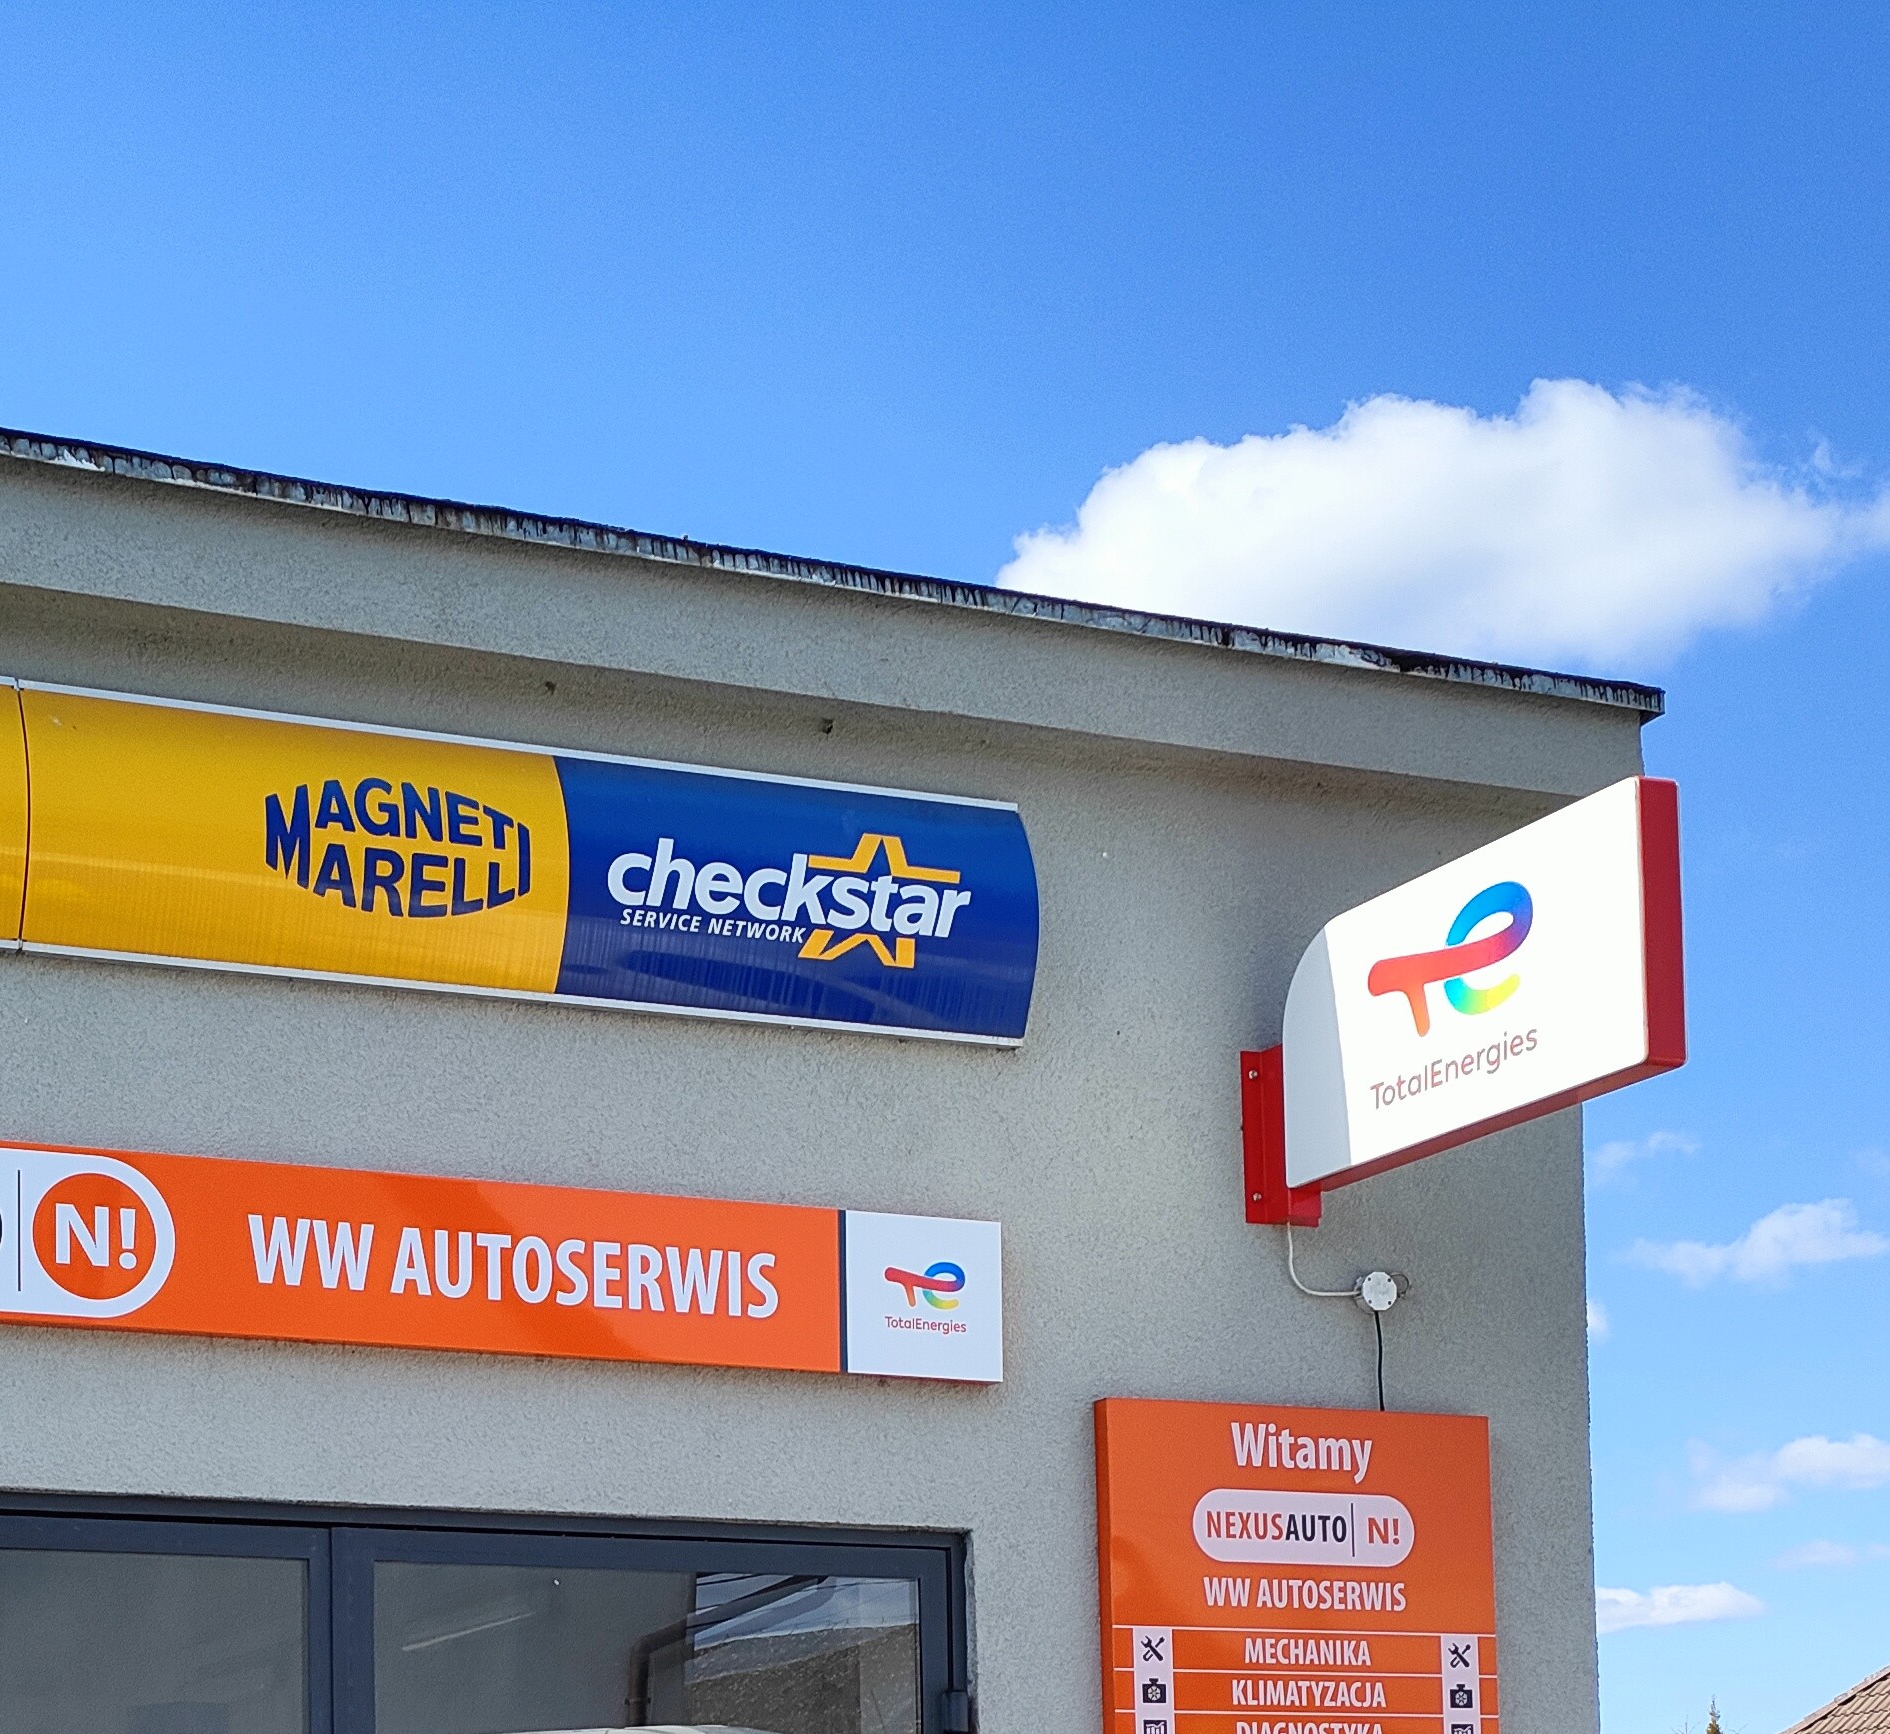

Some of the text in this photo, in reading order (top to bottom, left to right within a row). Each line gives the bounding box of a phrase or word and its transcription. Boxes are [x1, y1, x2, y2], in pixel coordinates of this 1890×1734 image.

[265, 777, 530, 862] MAGNETI
[265, 838, 530, 918] MARELLI
[607, 837, 972, 938] checkstar
[619, 908, 807, 944] SERVICE NETWORK
[1369, 1028, 1539, 1111] TotalEnergies
[54, 1203, 138, 1270] N!
[247, 1213, 780, 1319] WW AUTOSERWIS
[884, 1315, 968, 1338] TotalEnergies
[1231, 1421, 1373, 1484] Witamy
[1367, 1517, 1400, 1546] N!
[1203, 1576, 1407, 1612] WW AUTOSERWIS
[1244, 1637, 1372, 1667] MECHANIKA
[1231, 1679, 1387, 1708] KLIMATYZACJA
